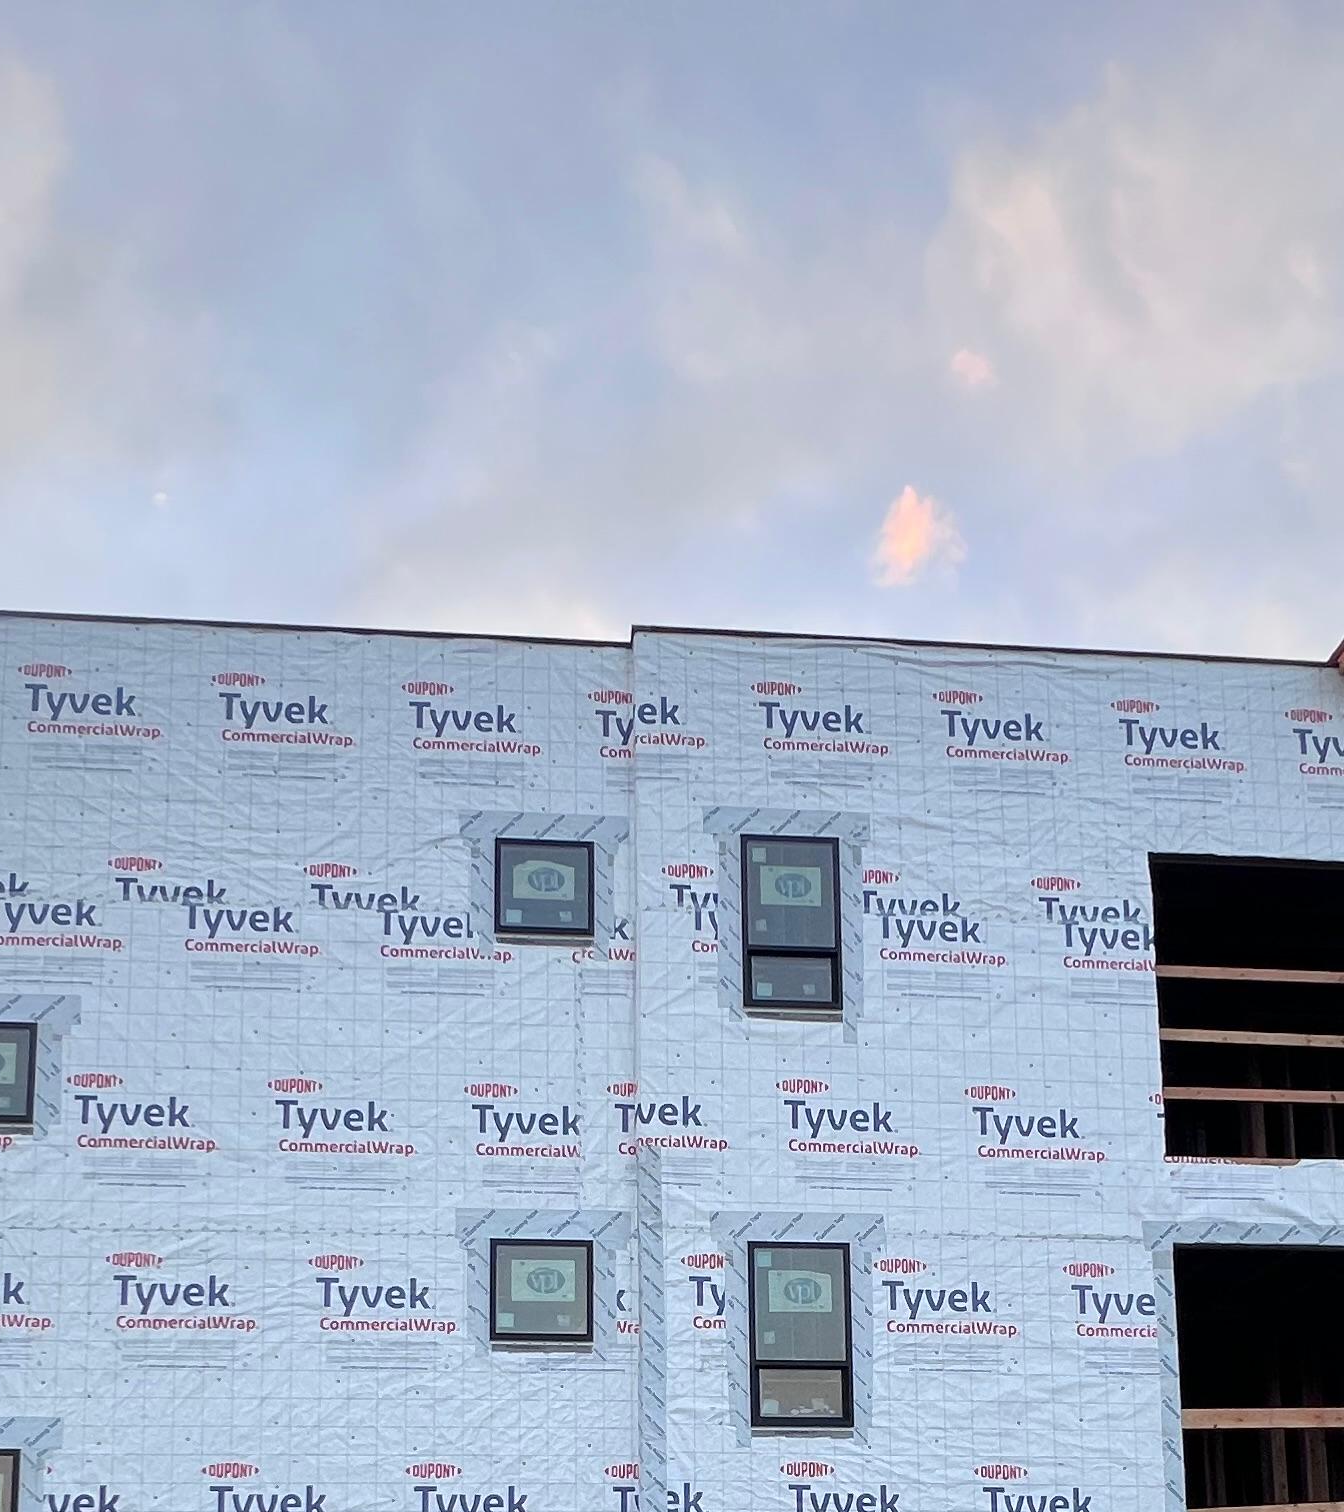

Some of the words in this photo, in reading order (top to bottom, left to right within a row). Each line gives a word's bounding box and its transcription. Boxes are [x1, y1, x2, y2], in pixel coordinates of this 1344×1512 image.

[25, 683, 135, 722] Tyvek
[219, 693, 328, 729] Tyvek
[759, 702, 864, 736] Tyvek
[941, 710, 1044, 746] Tyvek
[75, 1095, 189, 1134] Tyvek
[784, 1100, 892, 1138] Tyvek
[882, 1281, 991, 1320] Tyvek
